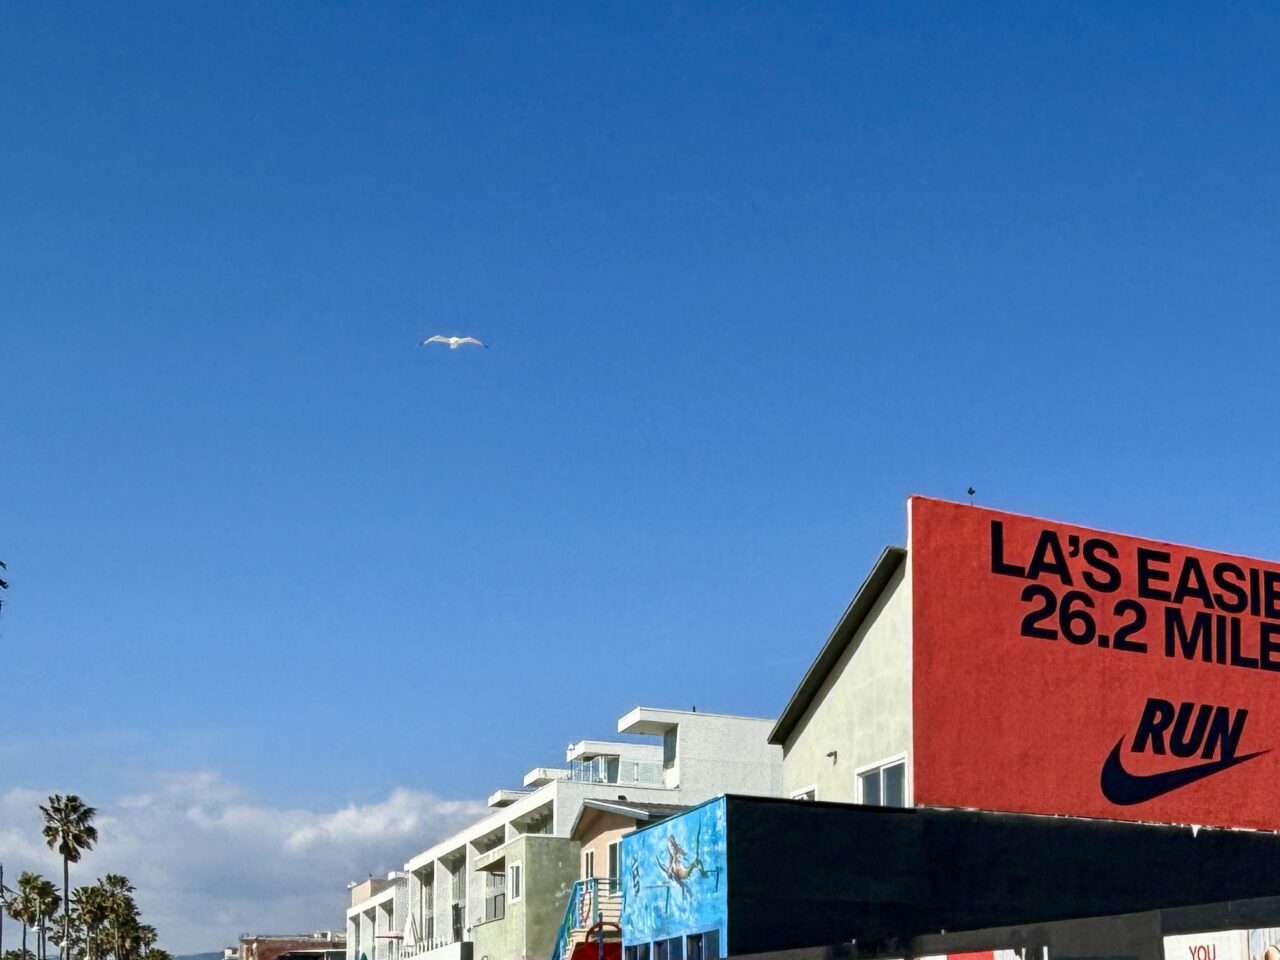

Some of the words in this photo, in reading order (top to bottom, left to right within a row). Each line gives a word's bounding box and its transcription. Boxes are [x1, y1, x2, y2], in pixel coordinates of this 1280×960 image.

[990, 520, 1121, 593] LA'S
[1021, 584, 1147, 654] 26.2
[1131, 697, 1248, 760] RUN
